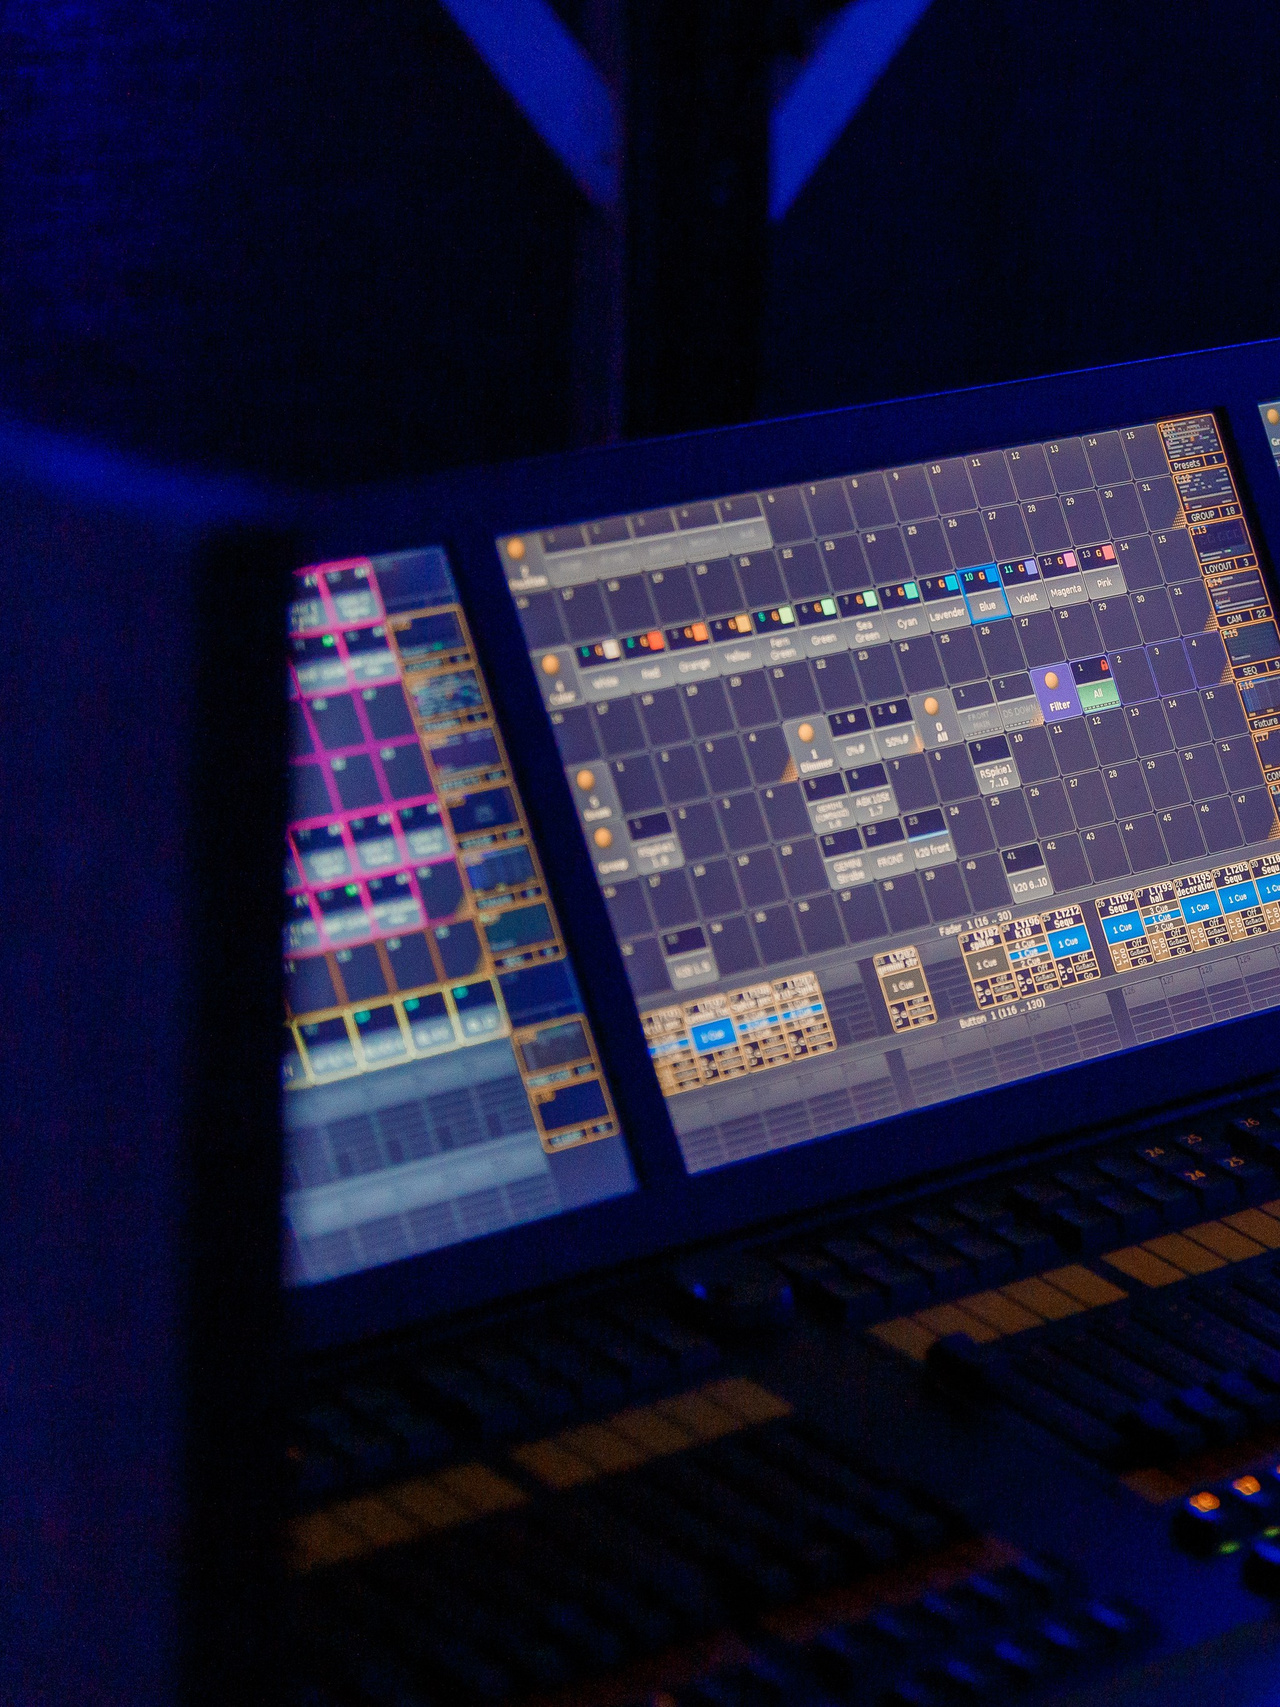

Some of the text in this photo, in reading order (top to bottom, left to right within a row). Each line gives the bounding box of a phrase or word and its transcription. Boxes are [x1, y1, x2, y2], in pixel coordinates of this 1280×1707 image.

[1126, 432, 1135, 440] 15
[1089, 438, 1097, 447] 14
[1050, 445, 1059, 453] 13
[1011, 451, 1020, 460] 12
[1213, 456, 1218, 464] 1
[1174, 459, 1201, 470] Presets
[932, 465, 941, 474] 10
[1142, 484, 1151, 492] 31
[1104, 491, 1113, 499] 30
[1066, 498, 1075, 506] 29
[1028, 505, 1036, 513] 28
[1226, 507, 1236, 516] 18
[1191, 511, 1215, 522] GROUP
[1190, 526, 1206, 535] 1.13
[1158, 536, 1167, 544] 15
[1120, 543, 1129, 551] 14
[1082, 550, 1091, 559] 13
[1044, 558, 1053, 566] 12
[1244, 558, 1249, 567] 3
[1004, 566, 1013, 574] 11
[1205, 561, 1232, 574] LOYOUT
[965, 573, 974, 582] 10
[1097, 578, 1113, 588] Pink
[1050, 584, 1082, 598] Magenta
[1174, 588, 1183, 596] 31
[1016, 592, 1039, 604] Violet
[1136, 595, 1145, 604] 30
[979, 601, 997, 612] Blue
[1099, 603, 1108, 611] 29
[929, 608, 965, 622] Lavender
[1060, 611, 1069, 619] 28
[1257, 609, 1267, 618] 22
[897, 618, 918, 630] Cyan
[1227, 614, 1243, 625] CAM
[811, 634, 837, 646] Green
[1116, 655, 1122, 663] 2
[1078, 664, 1084, 672] 1
[1275, 661, 1280, 669] 9
[1243, 666, 1258, 676] SEQ
[1094, 688, 1104, 698] All
[1049, 701, 1071, 712] Filter
[1168, 700, 1177, 708] 14
[1131, 708, 1140, 717] 13
[1092, 717, 1101, 725] 12
[1254, 717, 1279, 728] Fixture
[937, 732, 949, 743] All
[1201, 805, 1210, 813] 46
[1163, 814, 1172, 822] 45
[1125, 823, 1134, 831] 44
[1086, 832, 1095, 841] 43
[1225, 863, 1248, 876] LT203
[1262, 864, 1280, 875] Sequ
[1187, 872, 1211, 886] LT195
[1224, 874, 1243, 885] Sequ
[1149, 883, 1173, 896] LT193
[1266, 886, 1271, 894] 1
[1109, 892, 1134, 906] LT192
[1229, 894, 1247, 904] 1 Cue
[1108, 903, 1128, 915] Sequ
[1191, 903, 1210, 914] 1 Cue
[1055, 907, 1081, 920] LT212
[1015, 917, 1040, 931] LT196
[1054, 917, 1074, 929] Sequ
[1209, 918, 1220, 928] Off
[939, 923, 962, 937] Fader
[1113, 924, 1133, 934] 1 Cue
[1059, 937, 1079, 949] 1 Cue
[1132, 939, 1143, 948] Off
[1215, 936, 1225, 945] Go
[1138, 957, 1148, 966] Go
